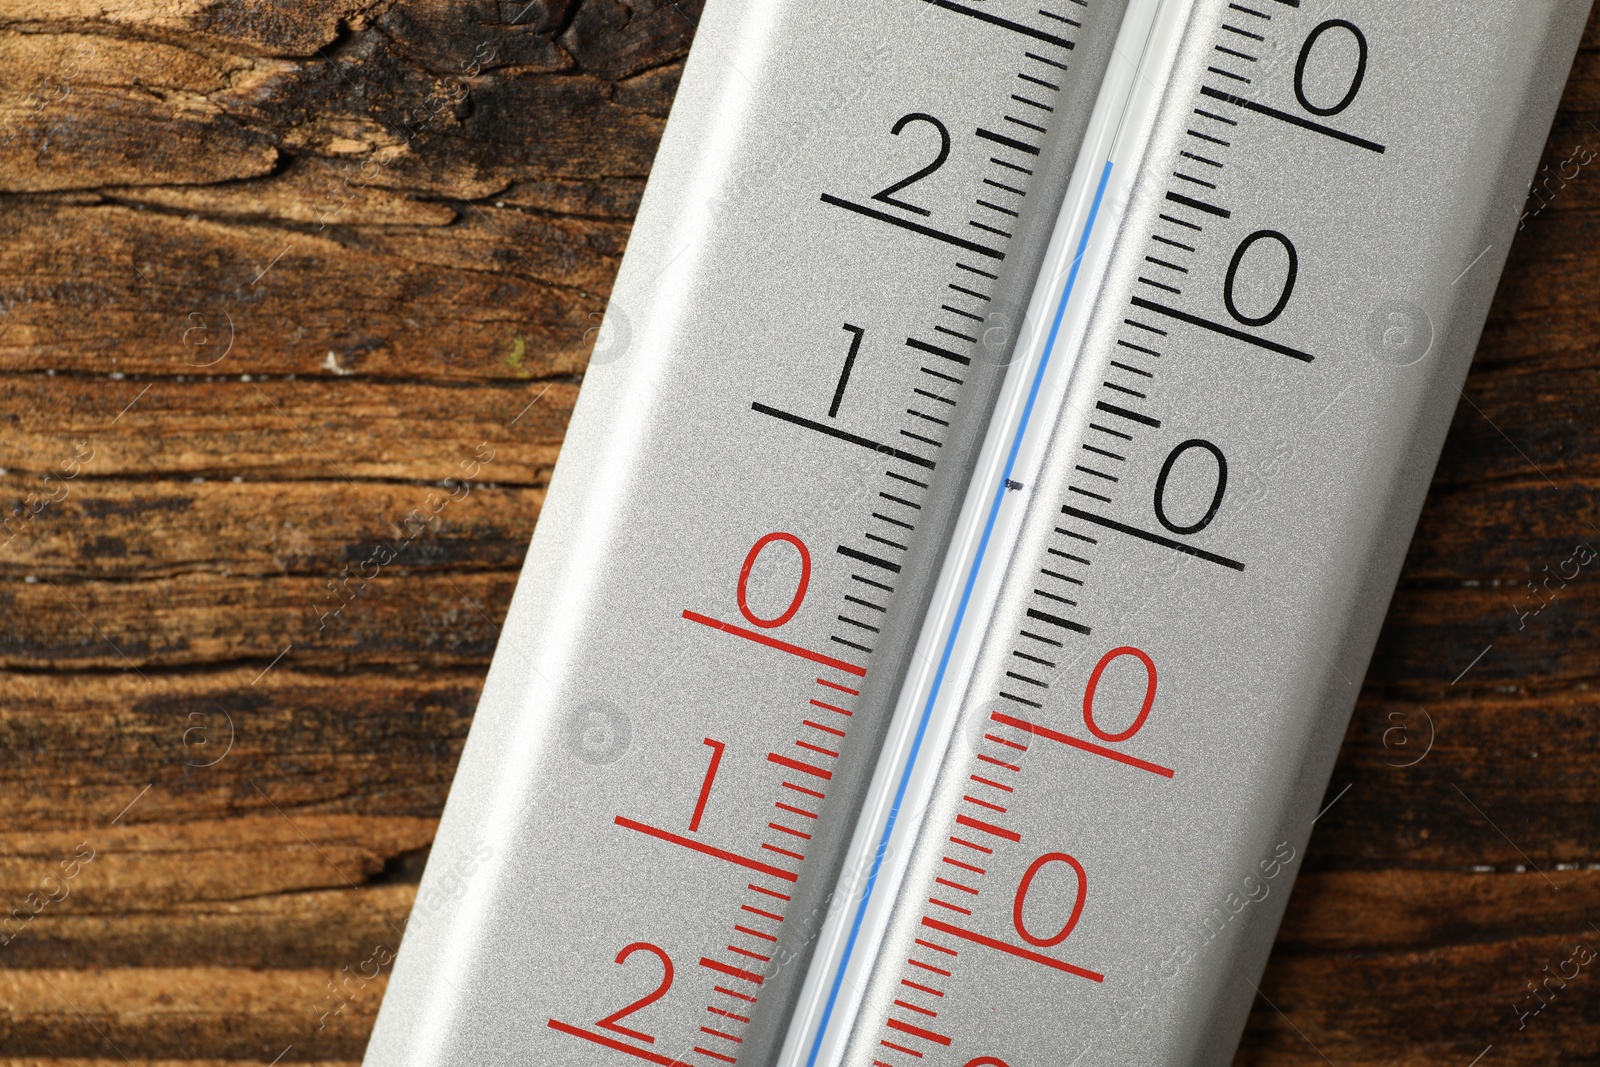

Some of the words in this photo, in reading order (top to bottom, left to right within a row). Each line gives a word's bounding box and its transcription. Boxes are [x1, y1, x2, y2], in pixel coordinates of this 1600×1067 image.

[1294, 19, 1367, 116] 0
[871, 113, 950, 217] 2
[1224, 230, 1297, 327] 0
[828, 323, 864, 417] 1
[1154, 439, 1227, 535] 0
[738, 533, 810, 628] 0
[1083, 647, 1156, 742] 0
[689, 738, 725, 831] 1
[1014, 853, 1086, 947] 0
[596, 942, 673, 1043] 2
